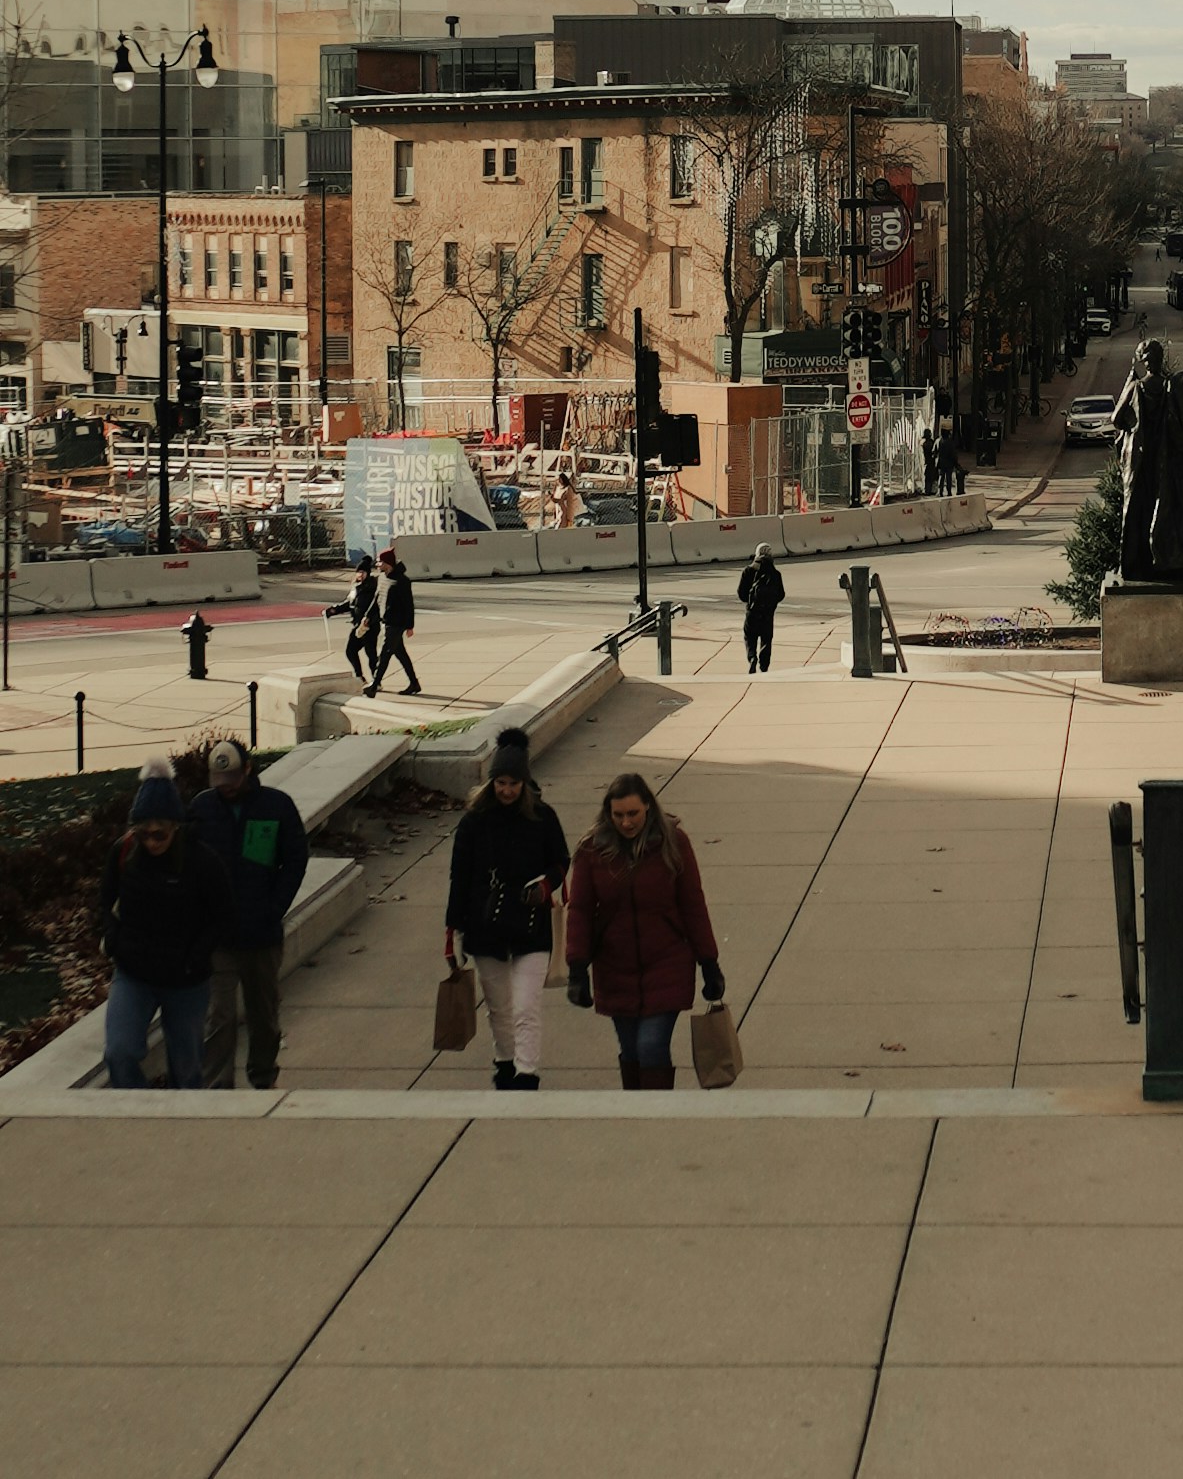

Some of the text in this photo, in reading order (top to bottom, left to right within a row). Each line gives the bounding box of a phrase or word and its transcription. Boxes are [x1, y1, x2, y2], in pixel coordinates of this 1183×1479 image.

[870, 214, 882, 252] BLOCK
[882, 207, 902, 251] 100
[920, 281, 930, 323] PIANO
[365, 455, 390, 536] FUTURE
[392, 509, 459, 537] CENTER
